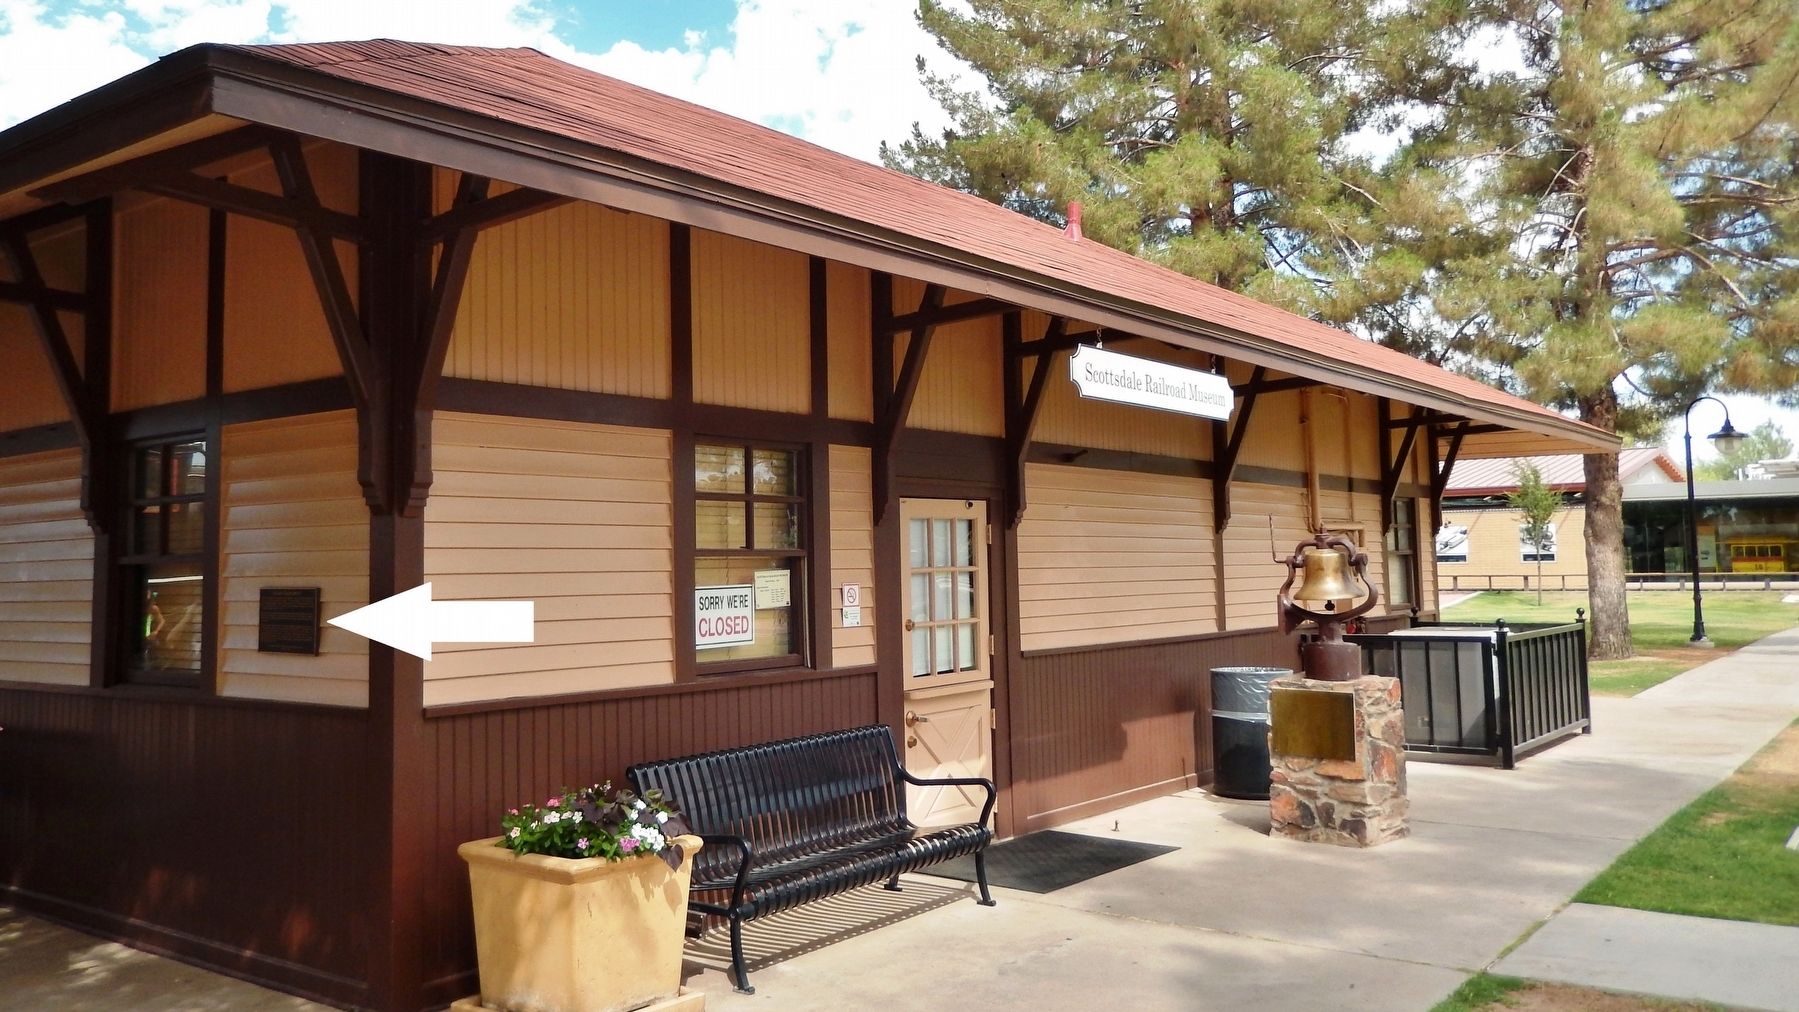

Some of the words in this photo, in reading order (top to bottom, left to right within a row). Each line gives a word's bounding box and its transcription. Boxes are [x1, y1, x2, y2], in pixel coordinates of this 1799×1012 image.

[1085, 362, 1142, 391] Scottsdale
[1145, 374, 1186, 399] Railroad
[1189, 383, 1226, 407] Museum
[699, 595, 724, 611] SORRY
[727, 594, 748, 609] WE'RE
[699, 615, 749, 637] CLOSED
